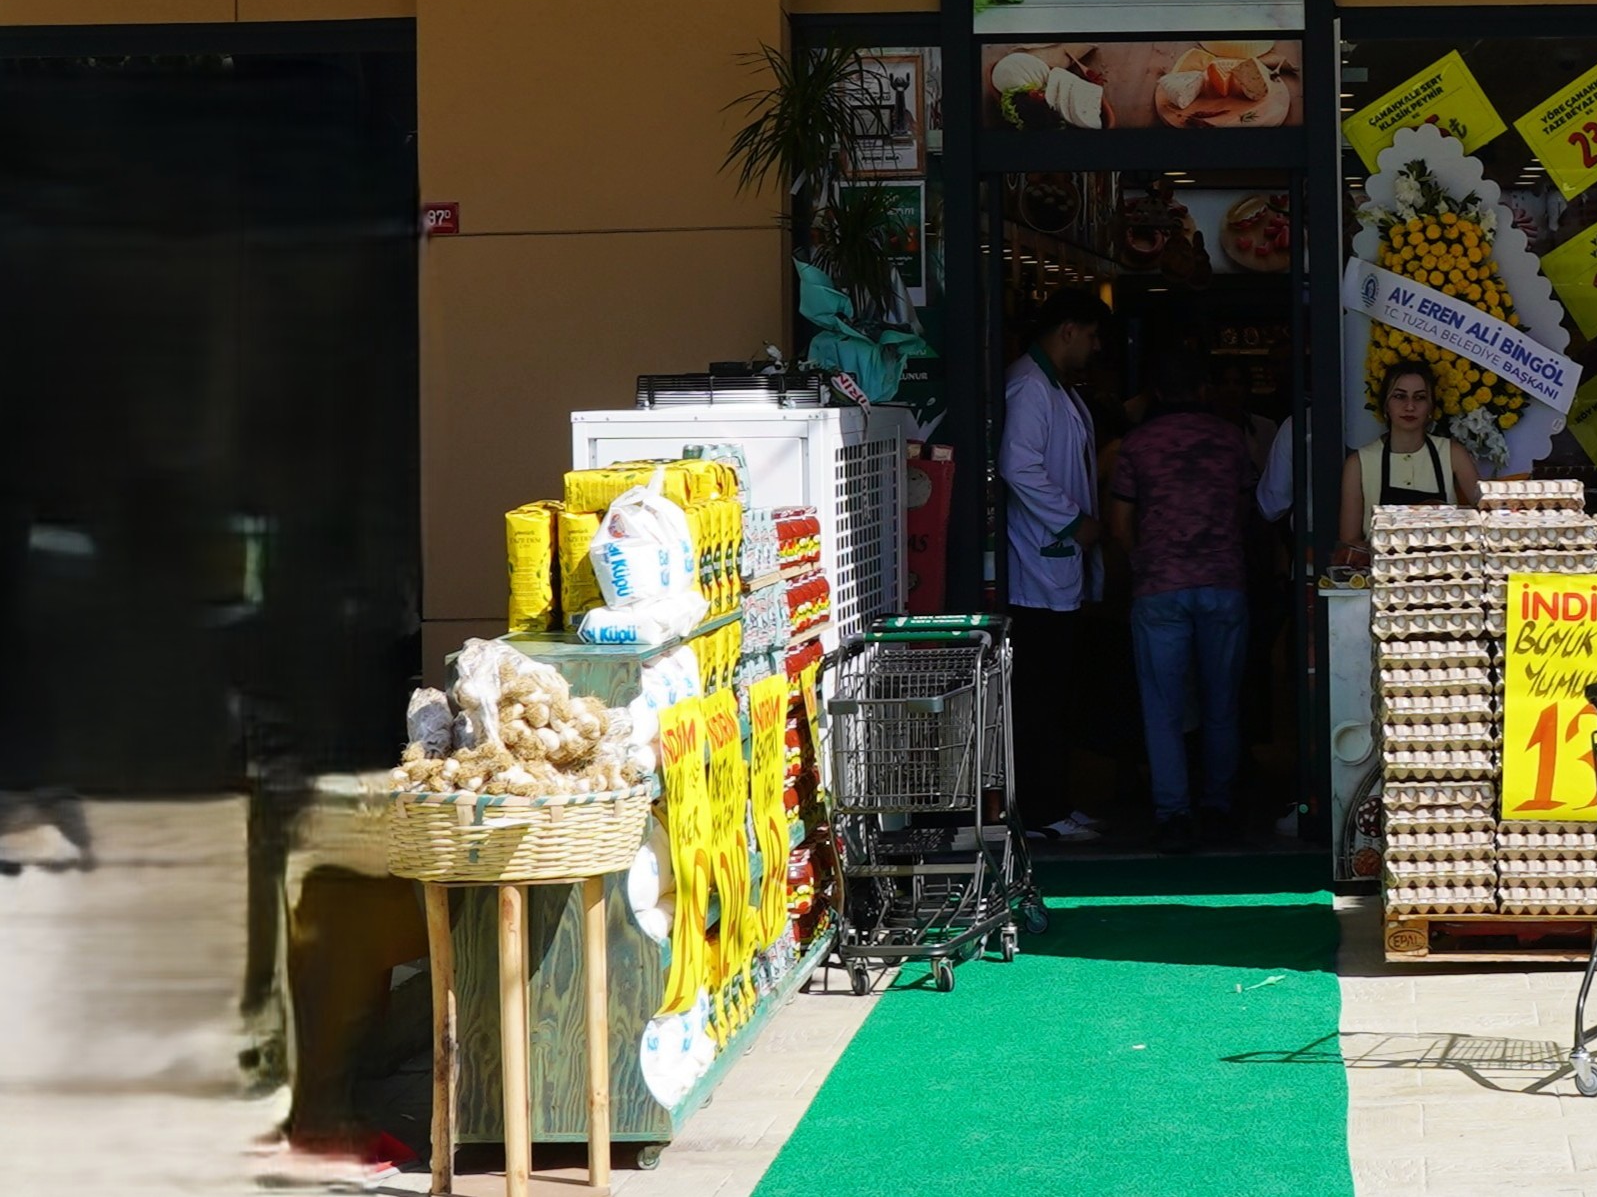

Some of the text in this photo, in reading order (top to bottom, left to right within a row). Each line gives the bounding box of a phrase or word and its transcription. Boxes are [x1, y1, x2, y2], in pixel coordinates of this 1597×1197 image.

[1368, 86, 1422, 127] ÇANAKKALE
[1420, 74, 1444, 92] SERT
[1378, 108, 1412, 132] KLASİK
[1411, 86, 1445, 115] PEYNİR
[1540, 102, 1567, 124] YÖRE
[1542, 114, 1568, 135] TAZE
[1565, 97, 1596, 120] BEYAZ
[1388, 287, 1565, 387] AV. EREN ALİ BİNGÖL
[1401, 312, 1439, 336] TUZLA
[1440, 328, 1502, 366] BELEDİYE
[1502, 360, 1560, 400] BAŞKANI
